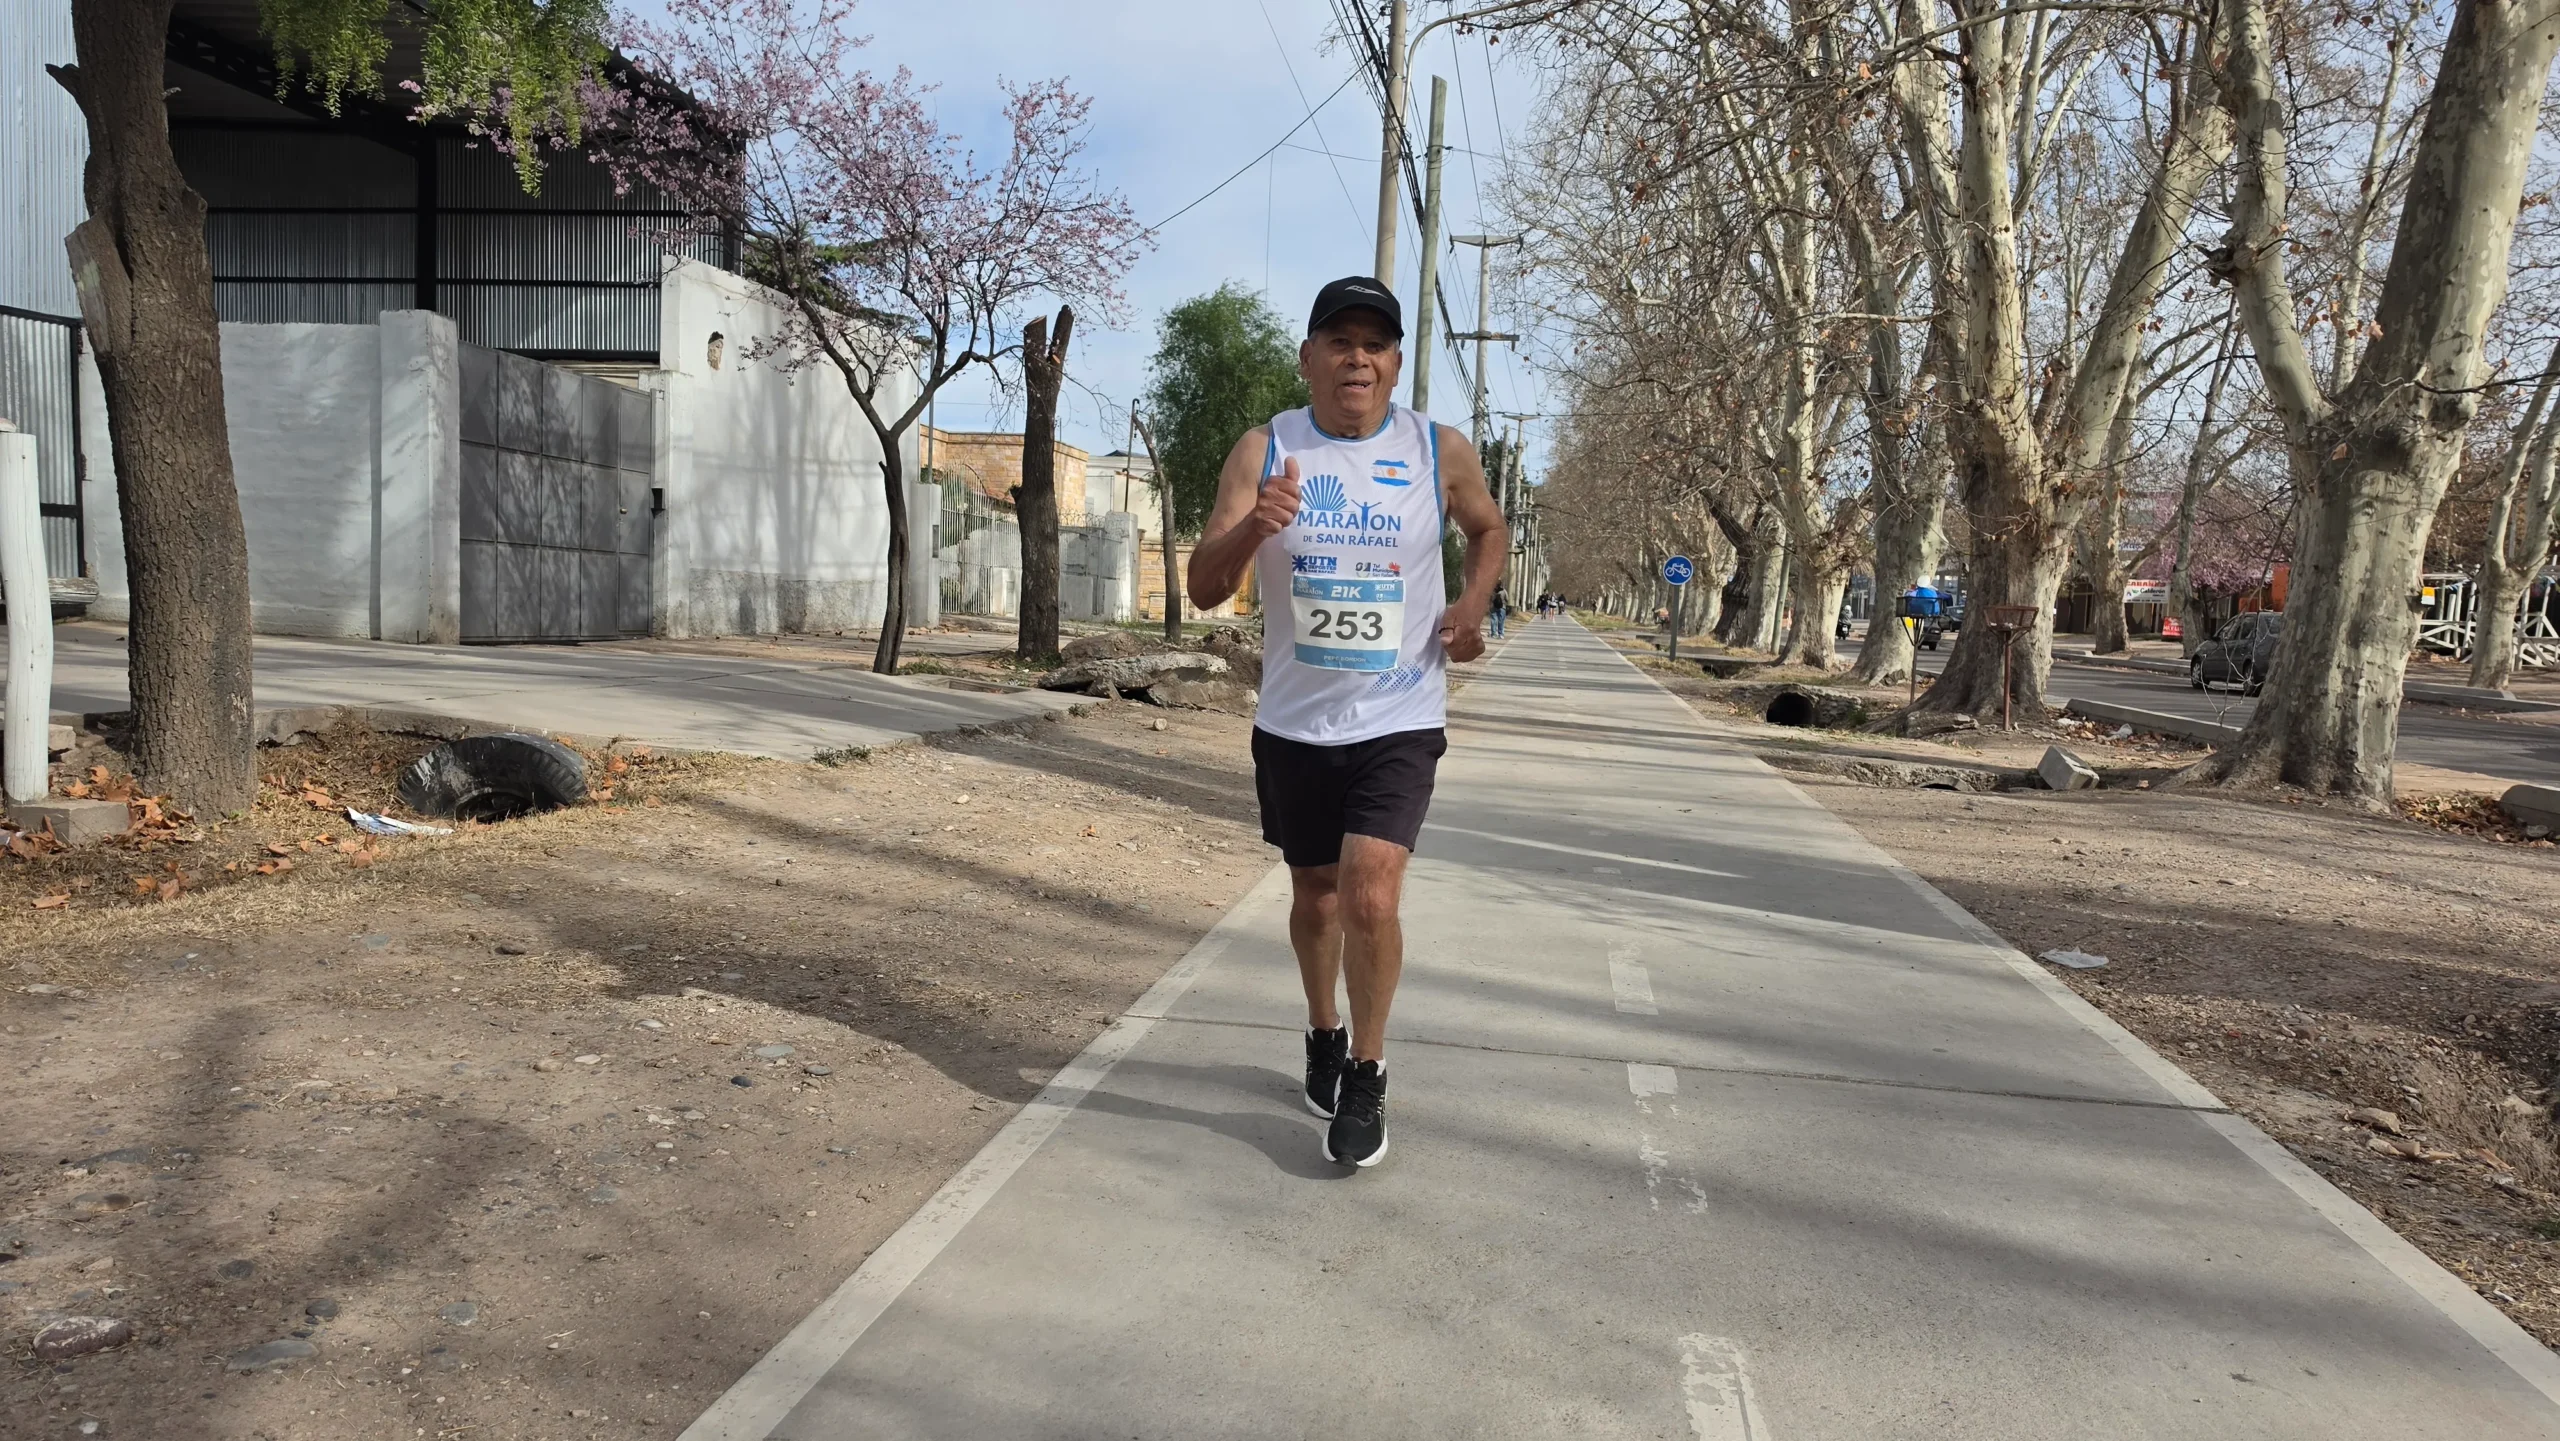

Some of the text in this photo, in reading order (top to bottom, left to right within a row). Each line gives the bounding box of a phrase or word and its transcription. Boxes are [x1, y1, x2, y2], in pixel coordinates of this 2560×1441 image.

[1303, 533, 1399, 548] DE SAN RAFAEL
[1309, 556, 1337, 566] UTN
[1330, 585, 1364, 599] 21K
[1308, 608, 1384, 642] 253
